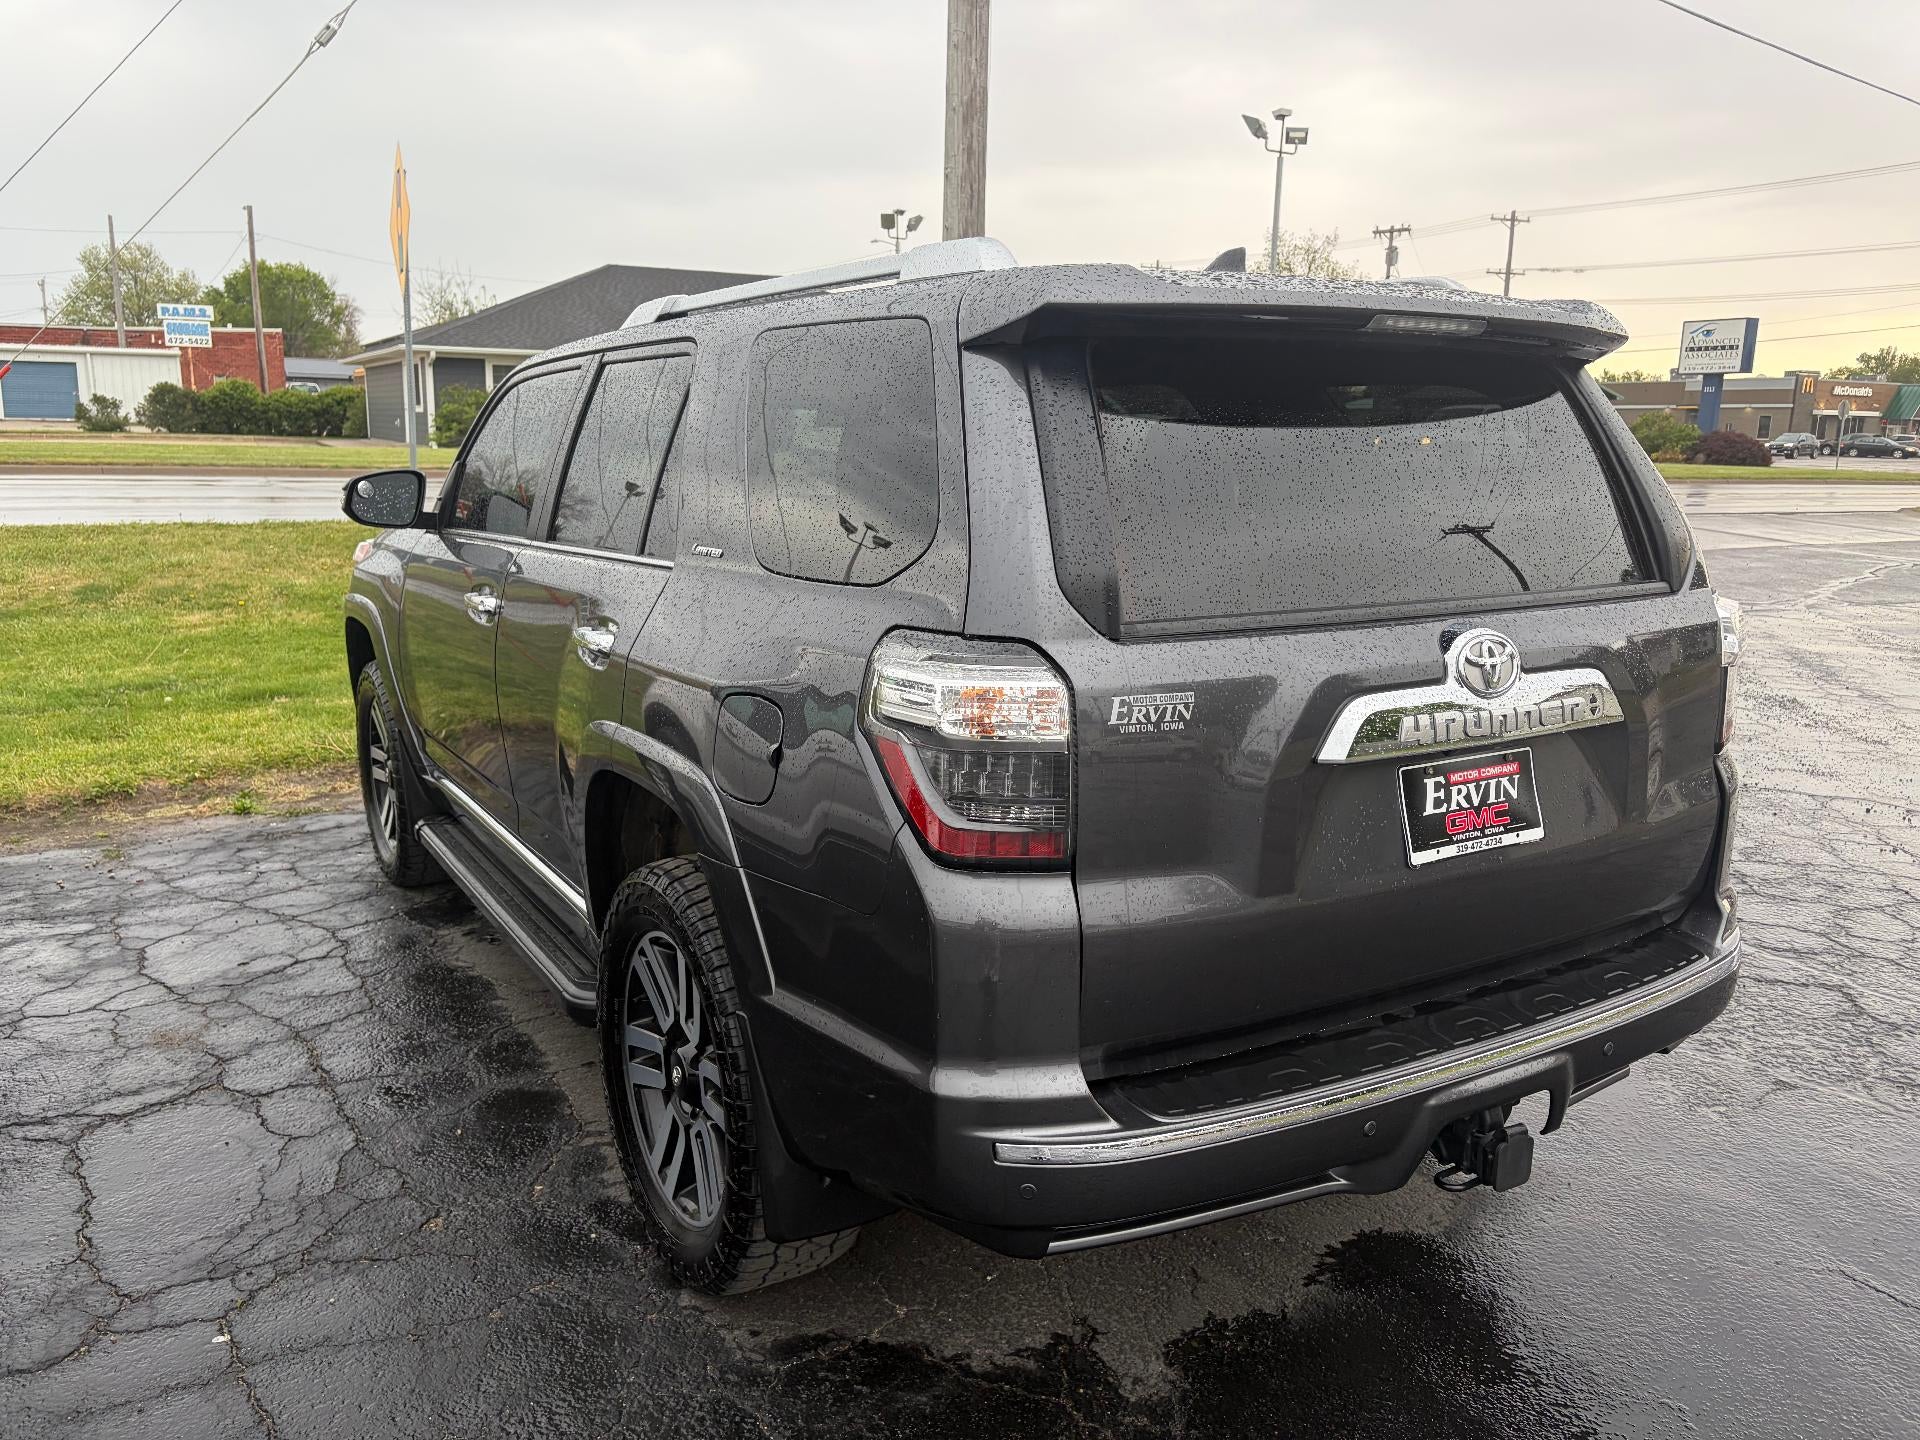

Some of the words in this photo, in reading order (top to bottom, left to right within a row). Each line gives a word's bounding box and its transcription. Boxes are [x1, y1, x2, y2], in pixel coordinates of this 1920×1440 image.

[168, 337, 209, 345] 472-5422
[1687, 335, 1741, 346] ADVANCED
[1684, 351, 1739, 360] ASSOCIATES
[1833, 385, 1873, 397] McDonald's
[1132, 695, 1158, 705] MOTOR
[1159, 692, 1194, 704] COMPANY
[1107, 696, 1195, 725] ERVIN
[1119, 723, 1157, 734] VINTON,
[1161, 721, 1185, 731] IOWA
[1450, 771, 1479, 783] MOTOR
[1481, 763, 1519, 777] COMPANY
[1422, 774, 1520, 817] ERVIN
[1445, 802, 1511, 835] GMC
[1452, 829, 1483, 842] VINTON,
[1484, 825, 1505, 836] IOWA
[1455, 837, 1503, 854] 319-472-4734
